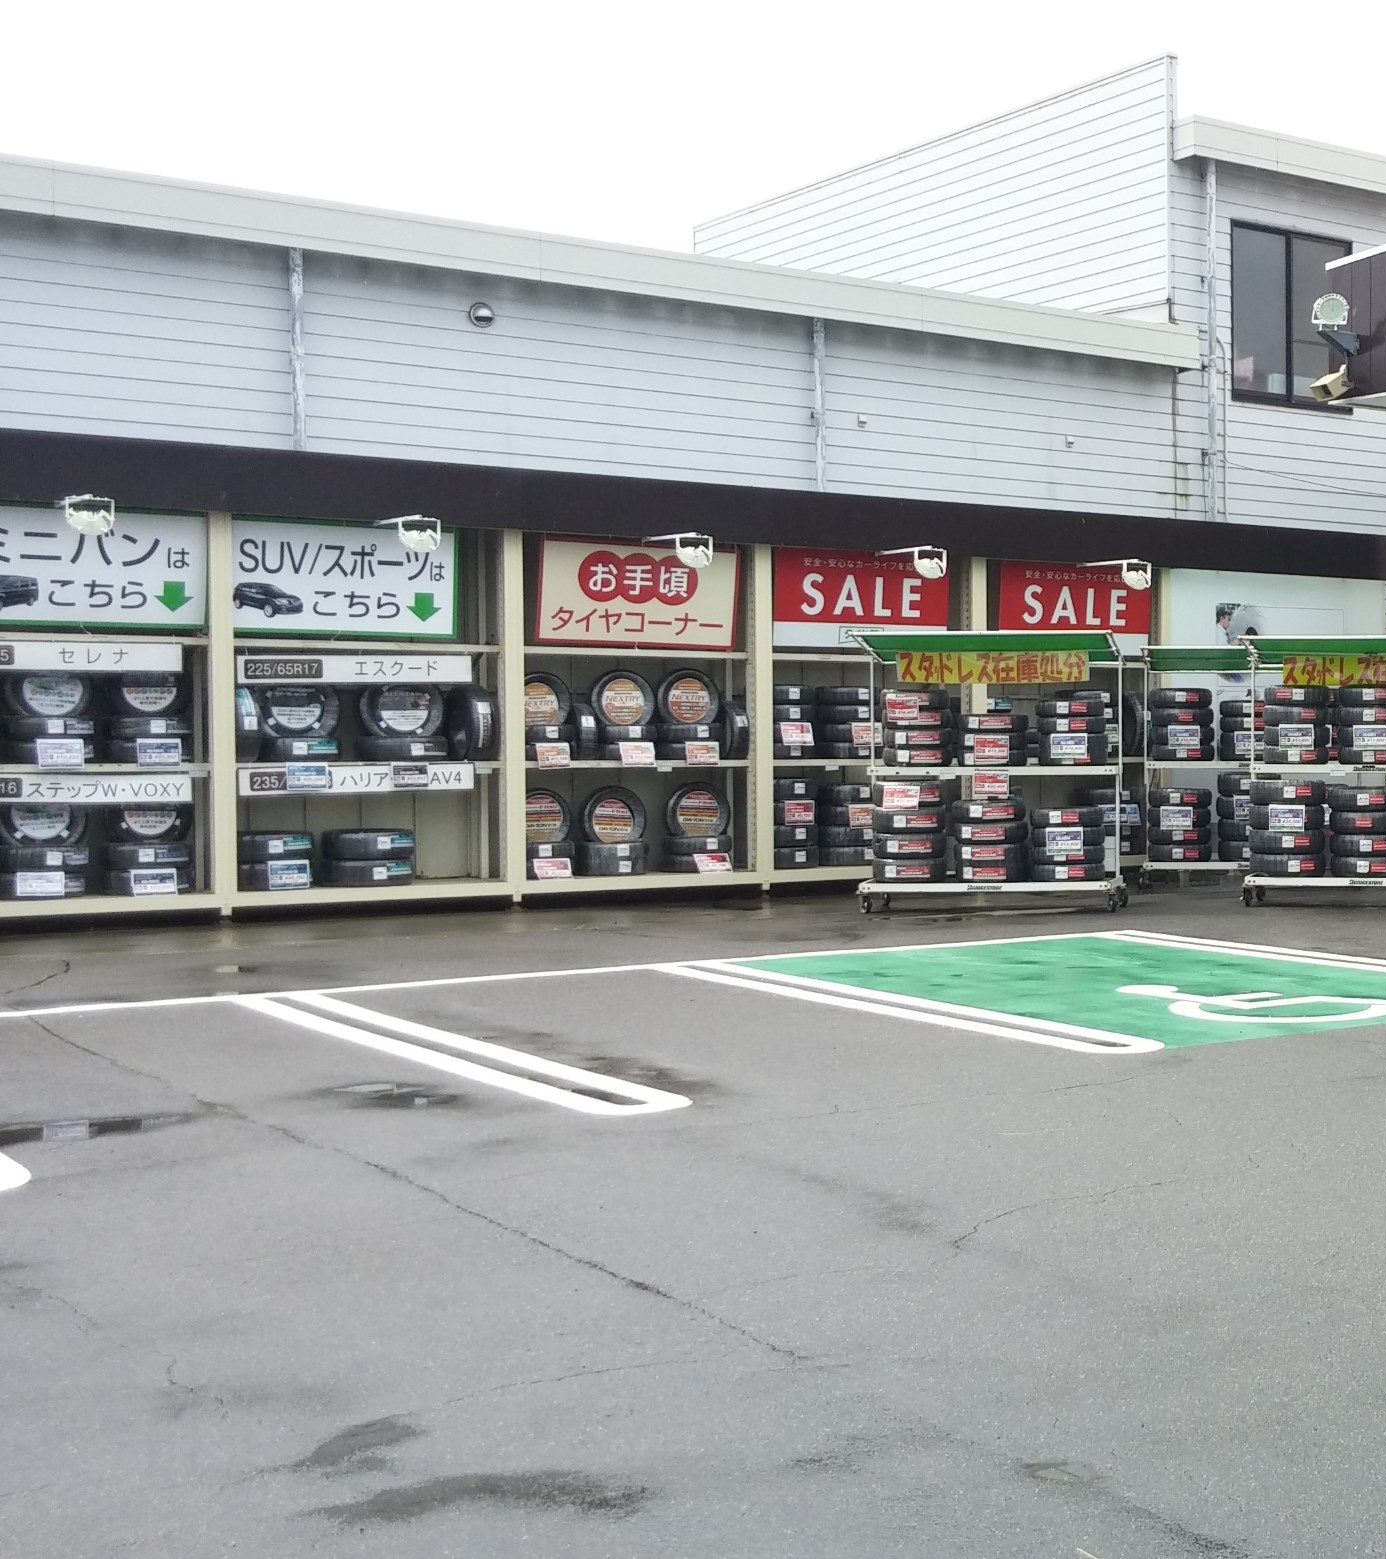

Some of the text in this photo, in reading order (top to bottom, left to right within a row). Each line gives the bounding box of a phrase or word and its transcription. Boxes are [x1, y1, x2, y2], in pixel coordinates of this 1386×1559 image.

[238, 538, 445, 582] SUV/スポーツは
[48, 579, 148, 609] こちら
[588, 562, 690, 598] お手頃
[801, 572, 923, 618] SALE
[312, 590, 401, 619] こちら
[1022, 584, 1128, 627] SALE
[551, 606, 724, 636] タイヤコーナー
[59, 647, 129, 665] セレナ
[246, 660, 439, 677] 225/65R17 エスクード
